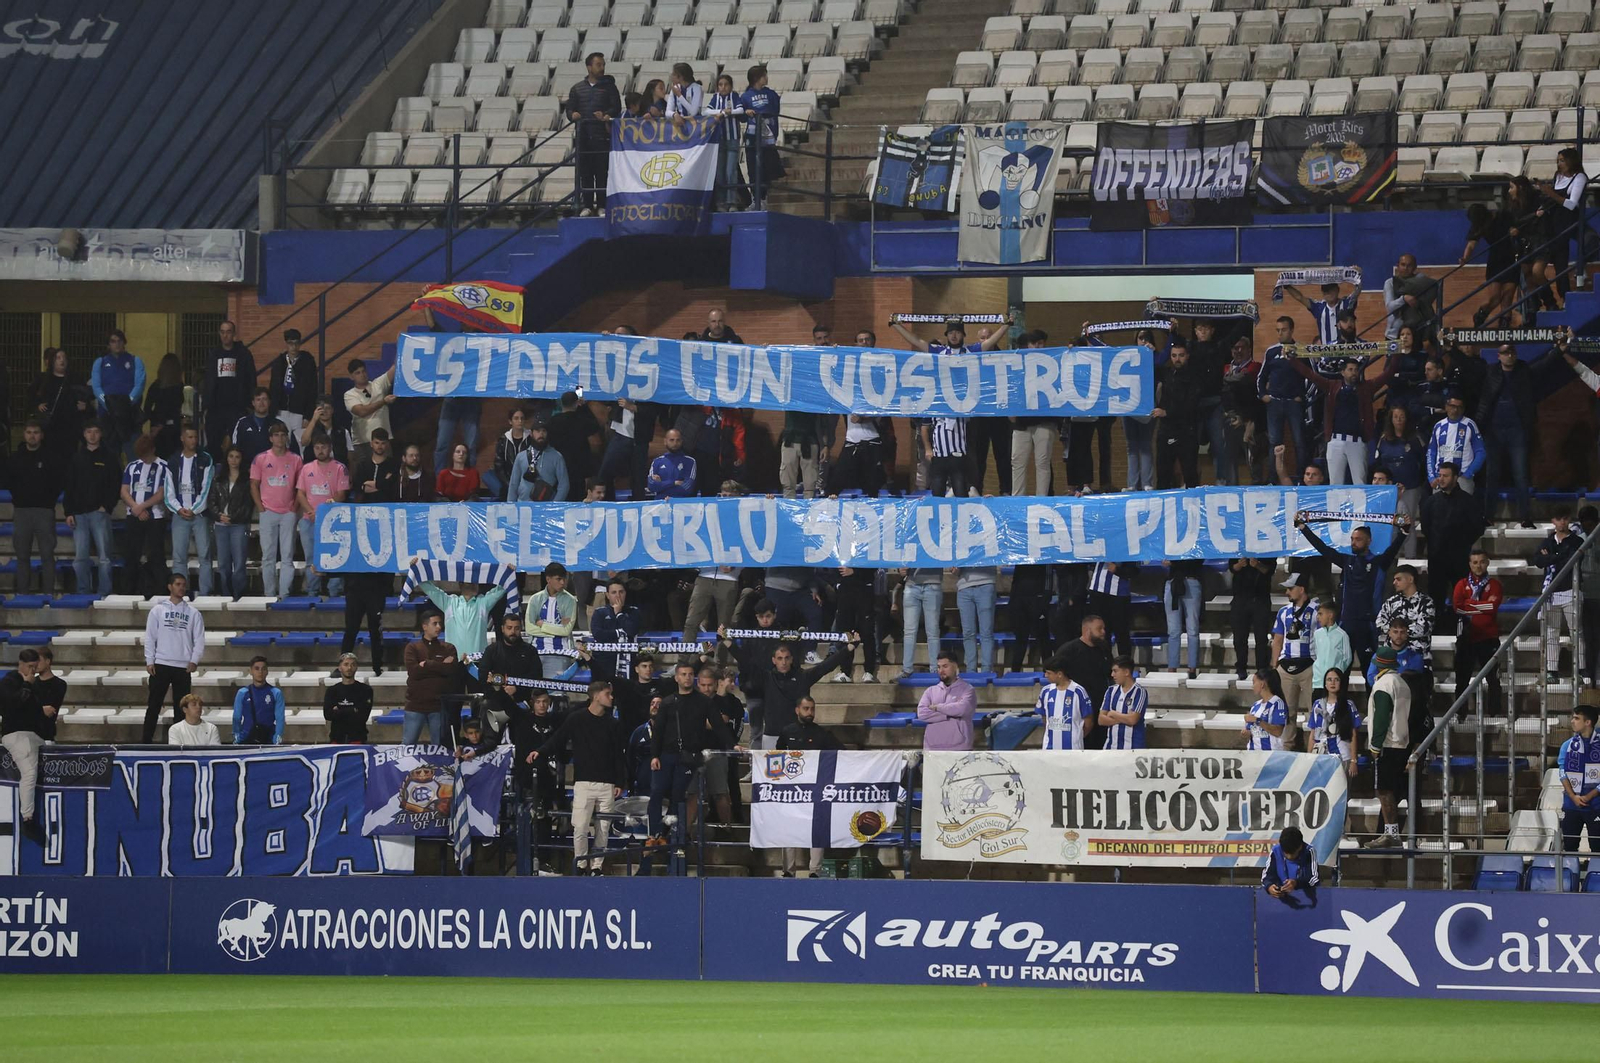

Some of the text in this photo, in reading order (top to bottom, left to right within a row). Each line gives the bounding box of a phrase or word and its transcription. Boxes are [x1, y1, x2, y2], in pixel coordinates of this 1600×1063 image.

[1094, 141, 1249, 201] DEFENDERS
[153, 244, 190, 259] alter
[490, 298, 515, 313] 89
[898, 313, 1004, 323] FRENTE ONUBA
[1088, 320, 1171, 333] RECREATIVISTAS
[401, 336, 1141, 413] ESTAMOS CON VOSOTROS
[1308, 511, 1394, 523] RECREATIVISTAS
[320, 488, 1367, 570] SOLO EL PUEBLO SALVA AL PUEBLO
[726, 629, 849, 642] FRENTE ONUBA
[586, 642, 704, 652] FRENTE ONUBA
[373, 744, 449, 766] BRIGADA
[1135, 756, 1243, 779] SECTOR
[759, 783, 890, 802] Banda Suicida
[1050, 784, 1330, 832] HELICÓSTERO
[396, 811, 438, 824] A WAY
[413, 820, 430, 830] OF
[945, 819, 1006, 844] Sector Helicóstero
[981, 836, 1019, 853] Gol Sur
[1096, 842, 1156, 854] DECANO
[1161, 842, 1177, 854] DEL
[1237, 843, 1274, 854] ESPA
[281, 907, 652, 950] ATRACCIONES LA CINTA S.L.
[1434, 902, 1600, 974] Caix
[927, 964, 1145, 983] CREA TU FRANQUICIA
